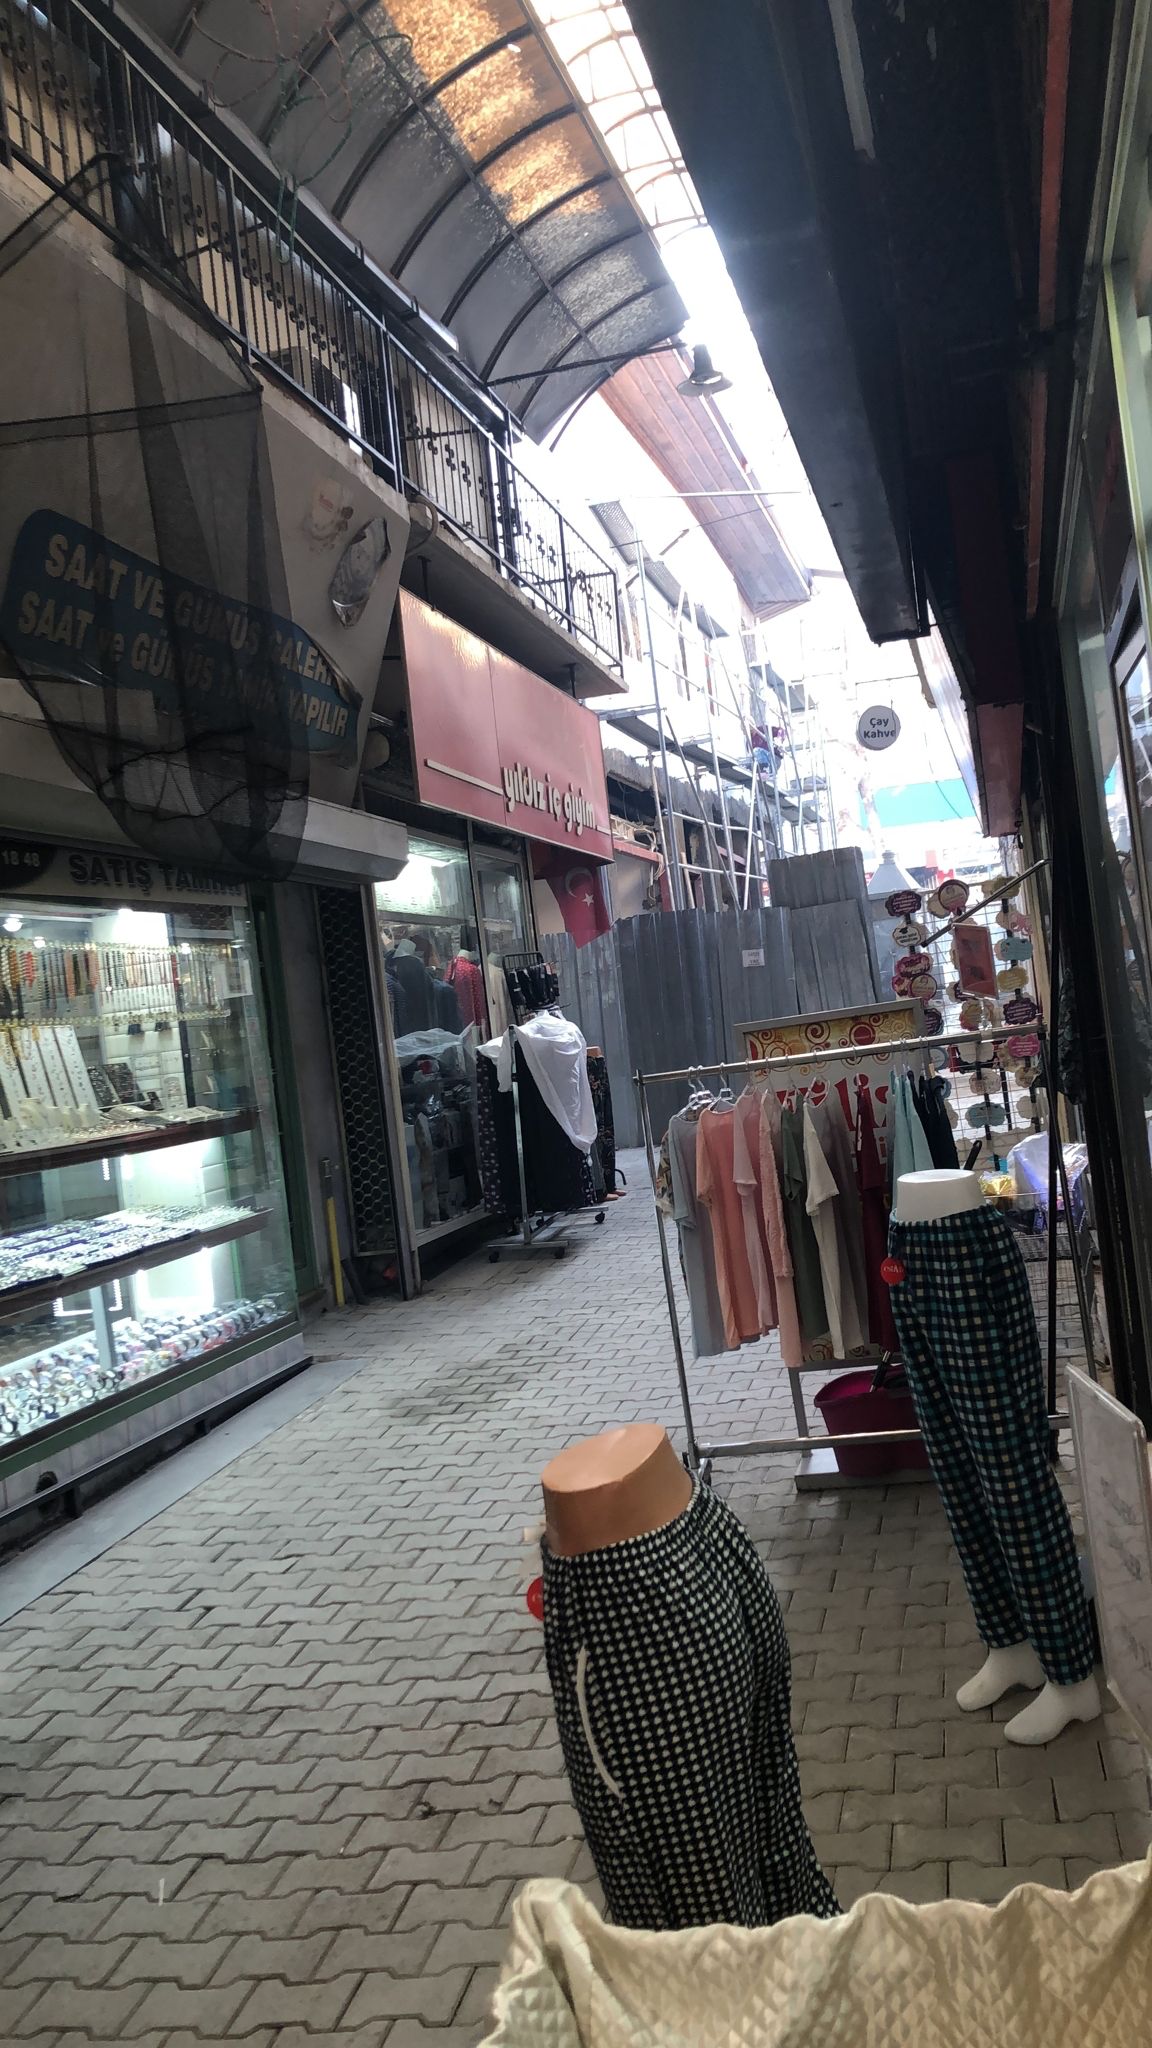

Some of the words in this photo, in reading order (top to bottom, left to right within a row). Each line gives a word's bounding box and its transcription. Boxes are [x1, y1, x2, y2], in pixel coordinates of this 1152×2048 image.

[45, 533, 127, 600] SAAT
[133, 570, 166, 619] VE
[271, 627, 337, 690] GALER
[17, 590, 95, 650] SAAT
[288, 688, 349, 738] YAPILIR
[863, 730, 896, 739] Kahve
[869, 717, 889, 729] Çay
[502, 762, 547, 813] yıldız
[546, 773, 562, 822] iç
[563, 783, 596, 837] giyim
[23, 852, 41, 868] 48
[68, 853, 154, 896] SATIŞ
